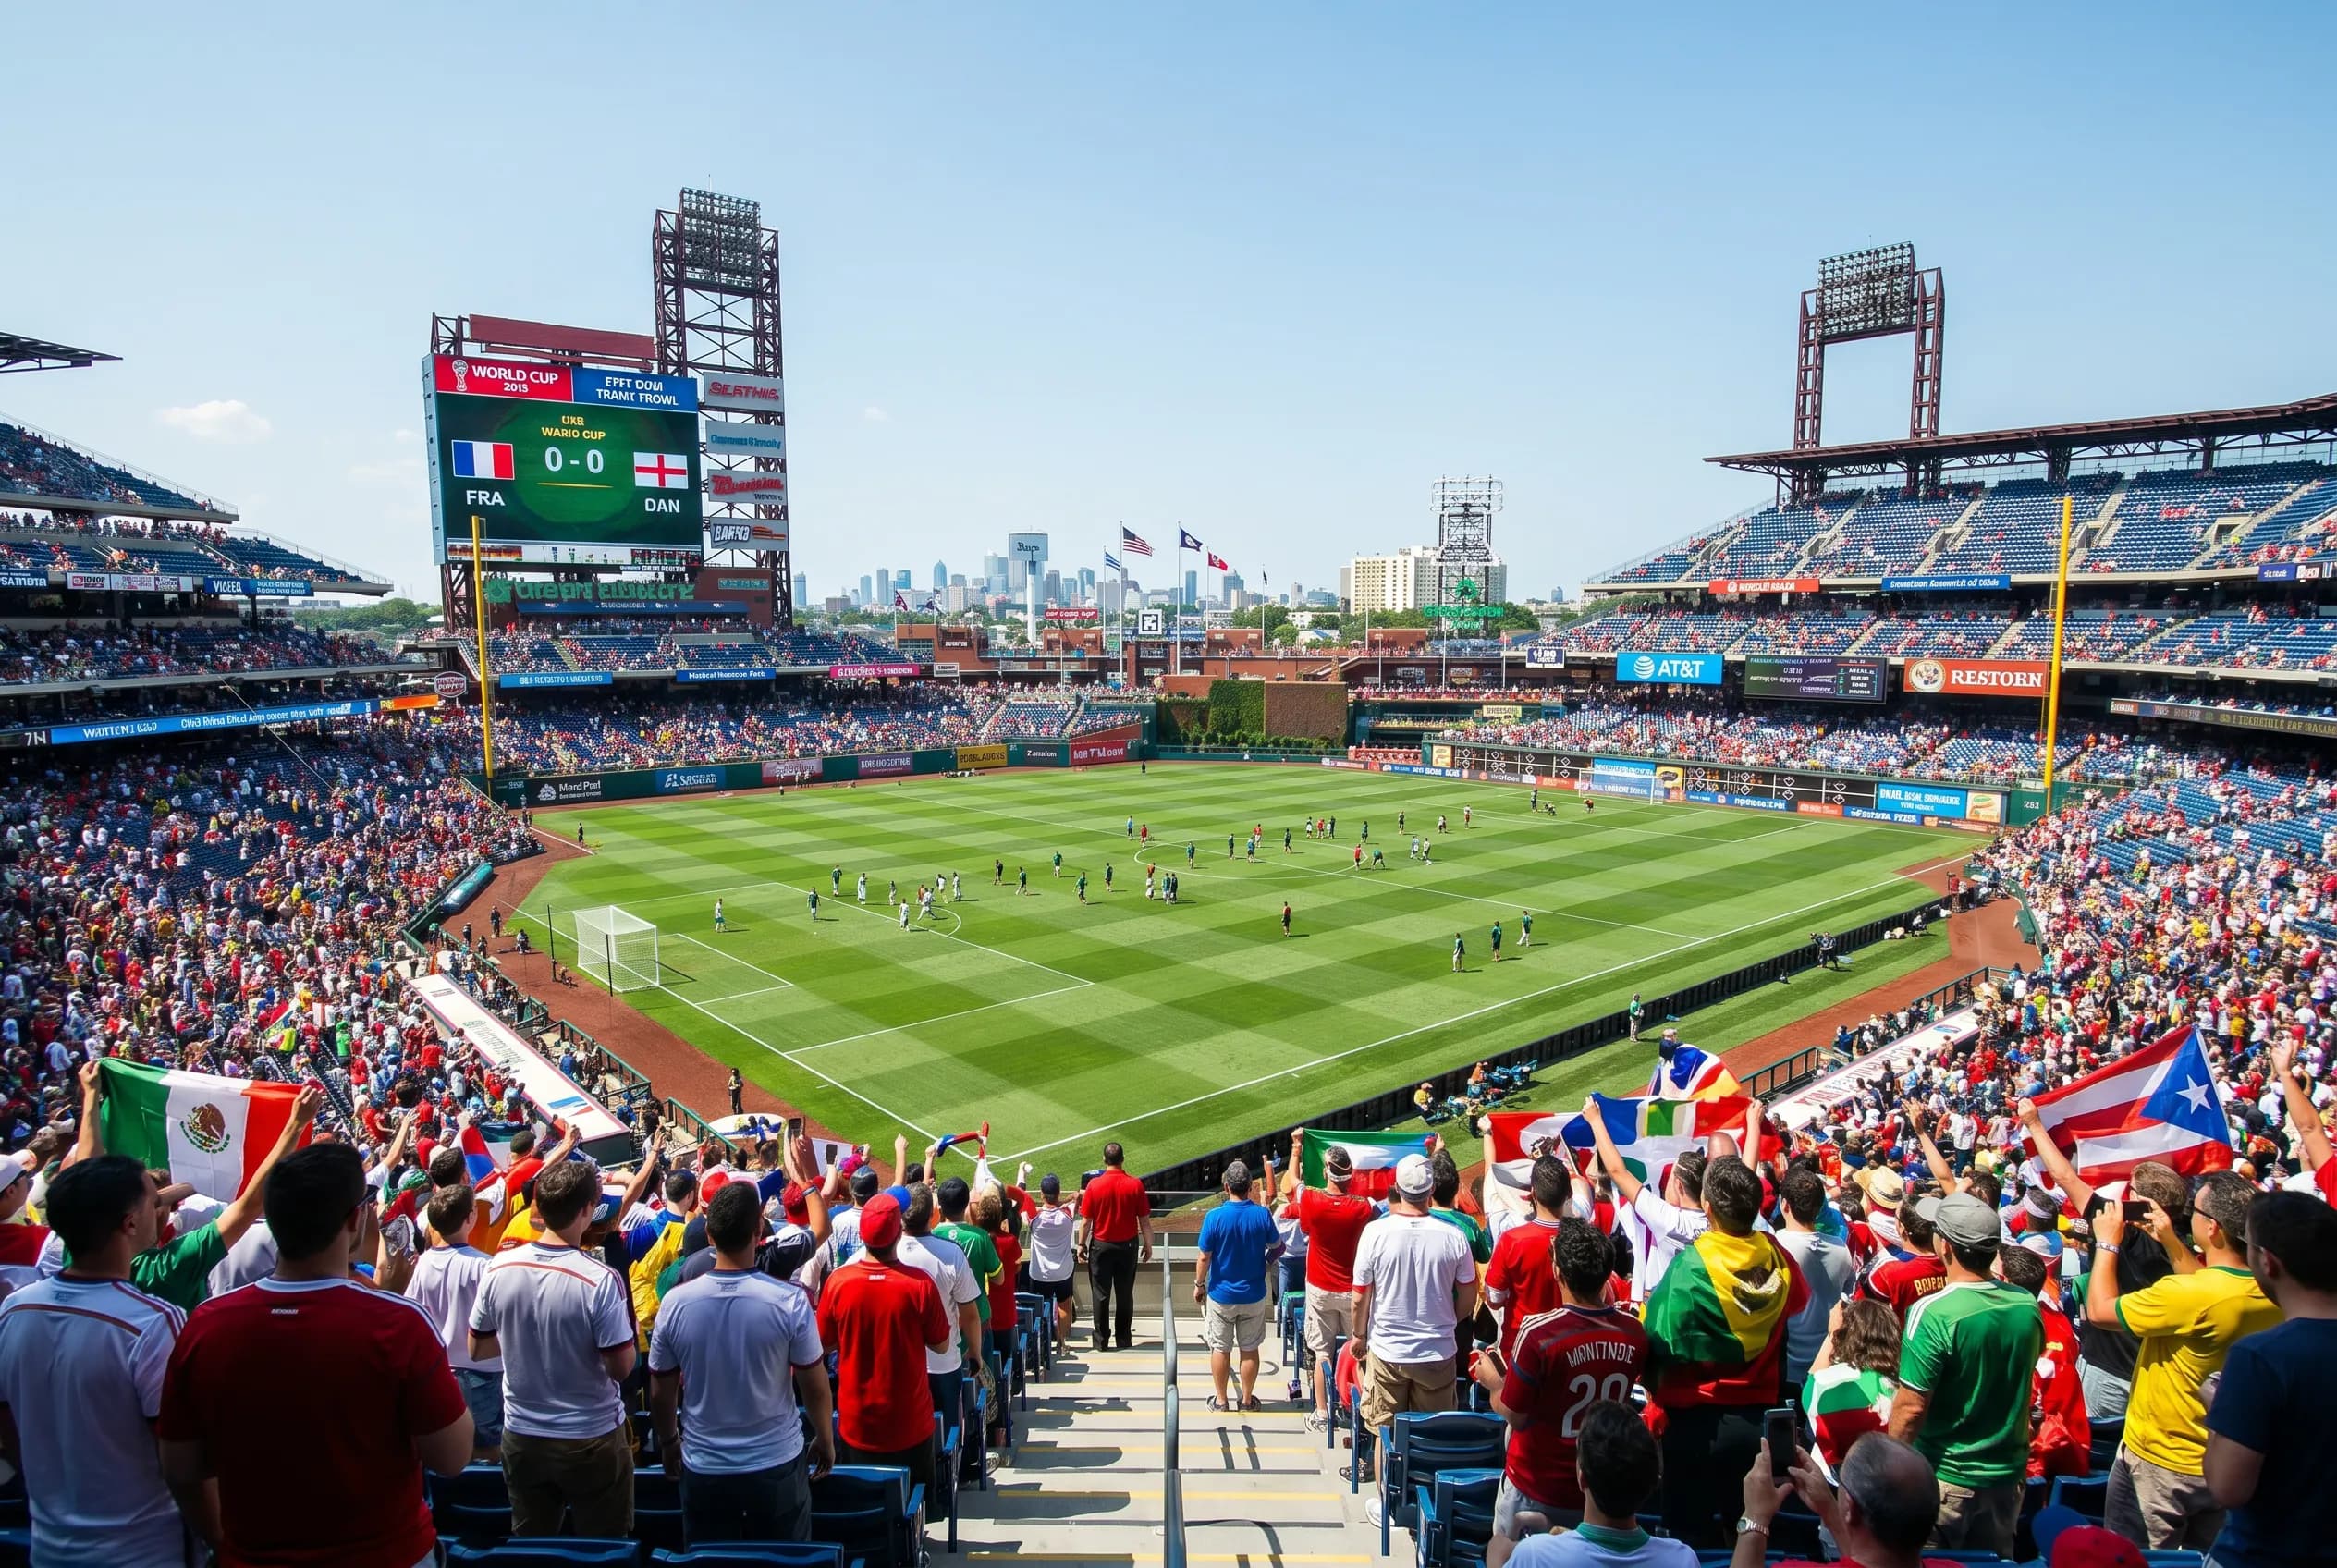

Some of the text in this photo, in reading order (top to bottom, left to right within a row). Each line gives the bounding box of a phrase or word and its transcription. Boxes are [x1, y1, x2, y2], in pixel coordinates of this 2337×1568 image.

[471, 365, 558, 385] WORLD CUP
[639, 393, 679, 407] FROWL
[541, 426, 606, 441] WARIO CUP
[544, 446, 563, 472] 0
[586, 448, 604, 474] 0
[465, 489, 506, 507] FRA
[644, 497, 680, 513] DAN
[1657, 659, 1705, 679] AT&T
[1951, 669, 2044, 688] RESTORN
